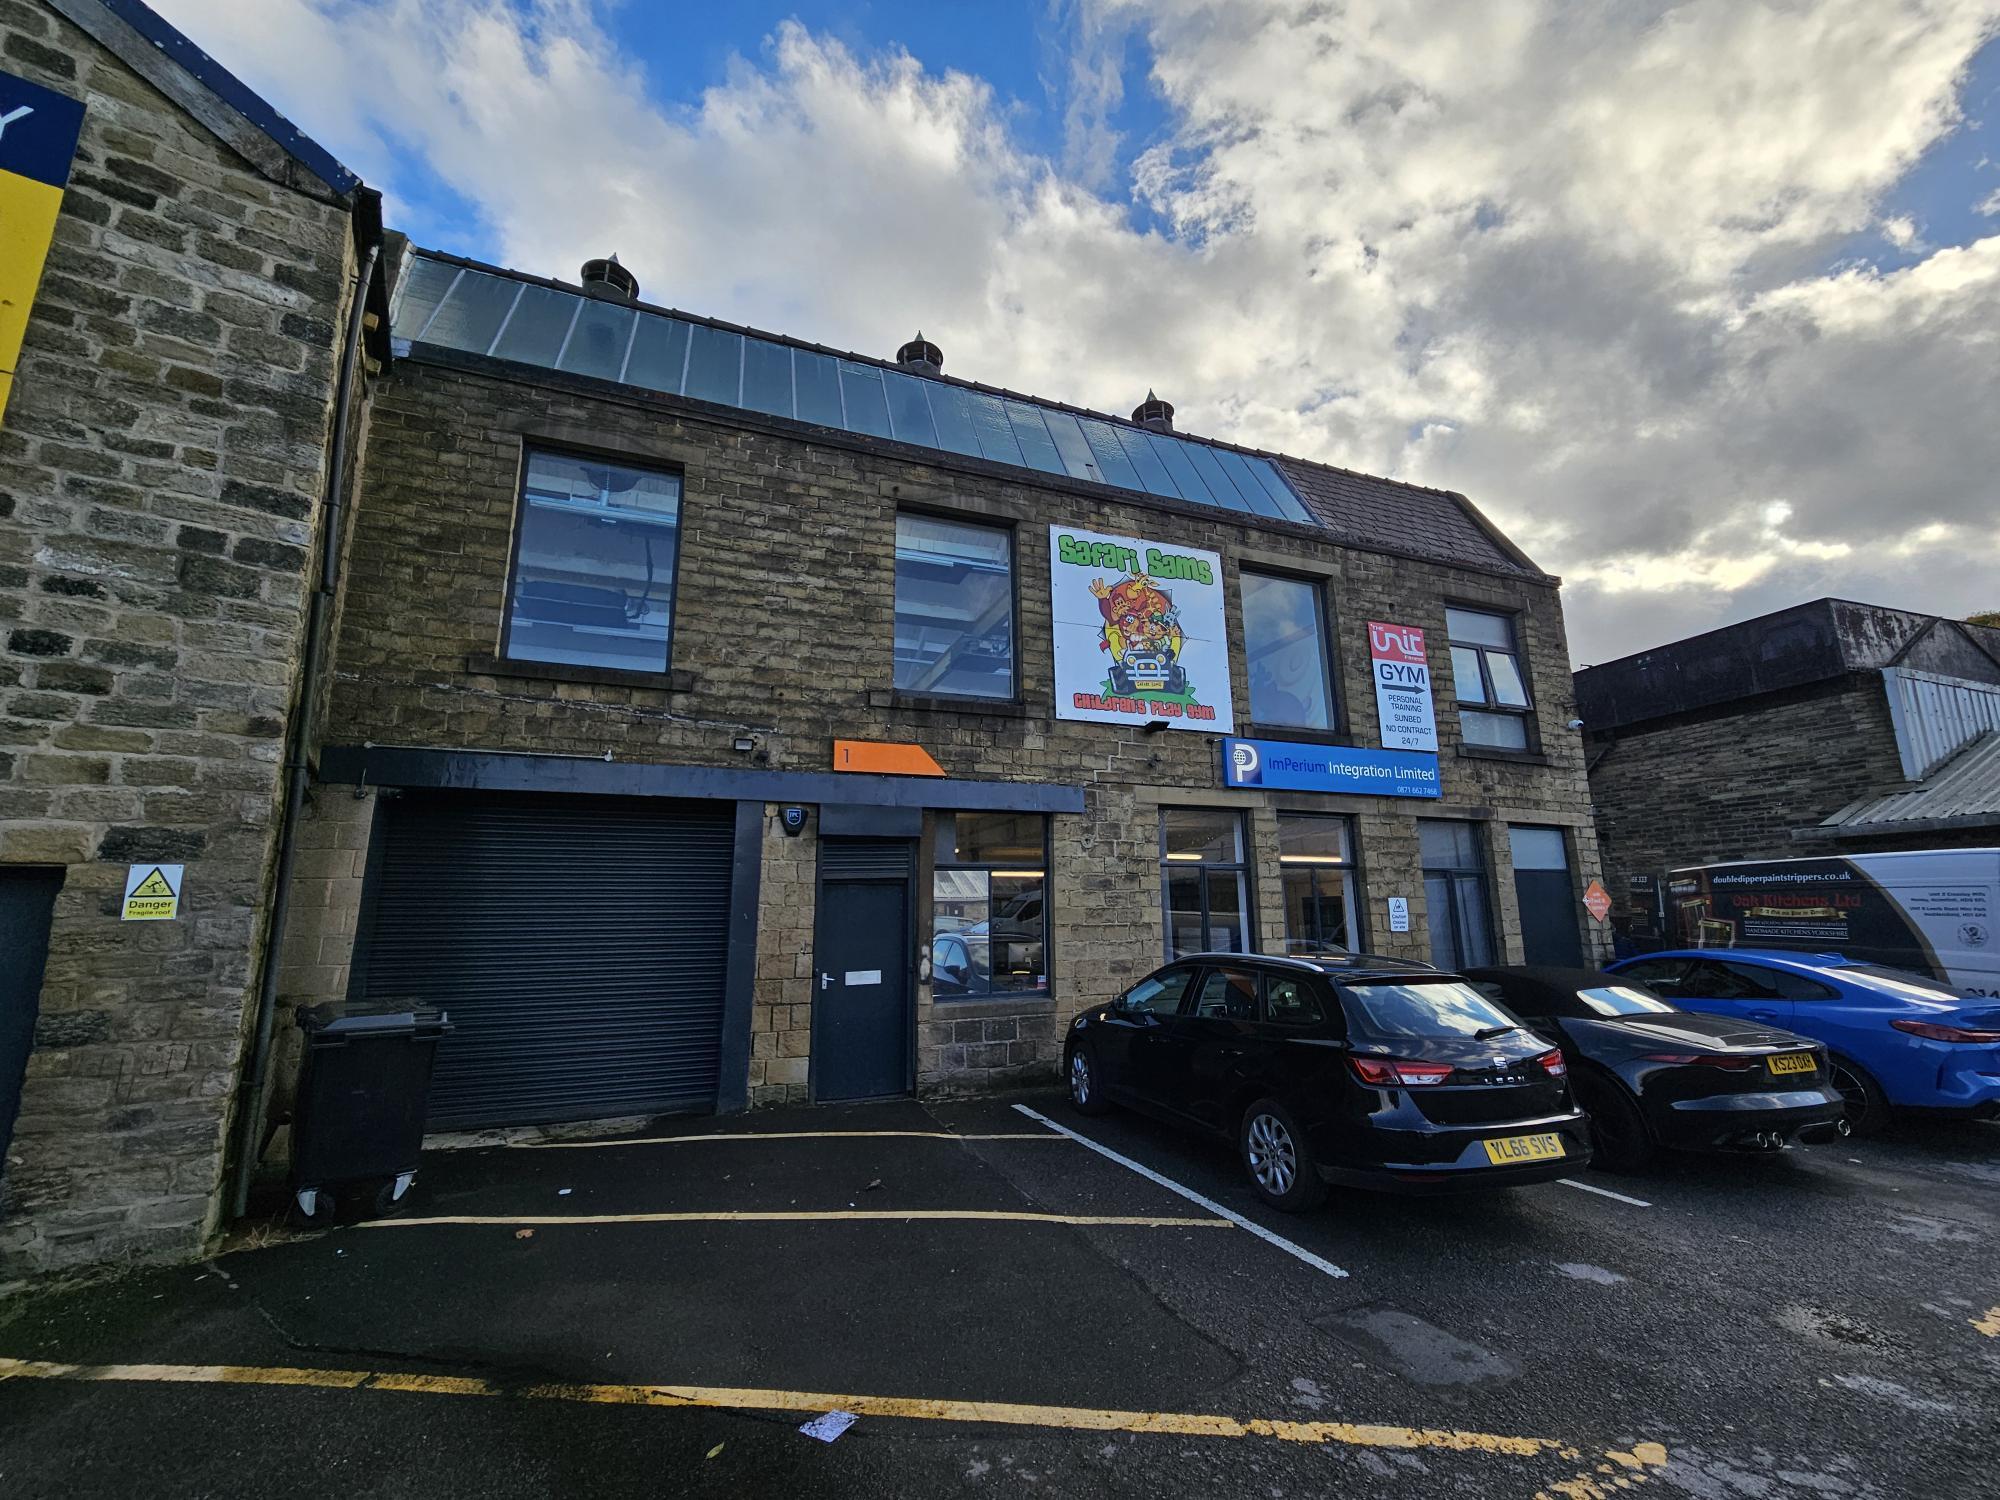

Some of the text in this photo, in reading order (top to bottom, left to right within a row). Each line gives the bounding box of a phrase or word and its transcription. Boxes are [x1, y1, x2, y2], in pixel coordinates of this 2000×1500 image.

[1058, 534, 1213, 585] Safari Sams
[1380, 664, 1425, 684] GYM
[1388, 695, 1423, 704] PERSONAL
[1391, 703, 1422, 712] TRAINING
[1394, 714, 1422, 723] SUNBED
[1386, 725, 1431, 735] NO CONTRACT
[1401, 737, 1419, 746] 24/7
[843, 748, 849, 763] 1
[1269, 757, 1436, 781] ImPerium Integration Limited
[1713, 872, 1851, 884] doubledipperpaintstrippers.co.uk
[129, 901, 173, 909] Danger
[1771, 1056, 1797, 1071] KS23
[1490, 1136, 1558, 1159] YL66 SVS
